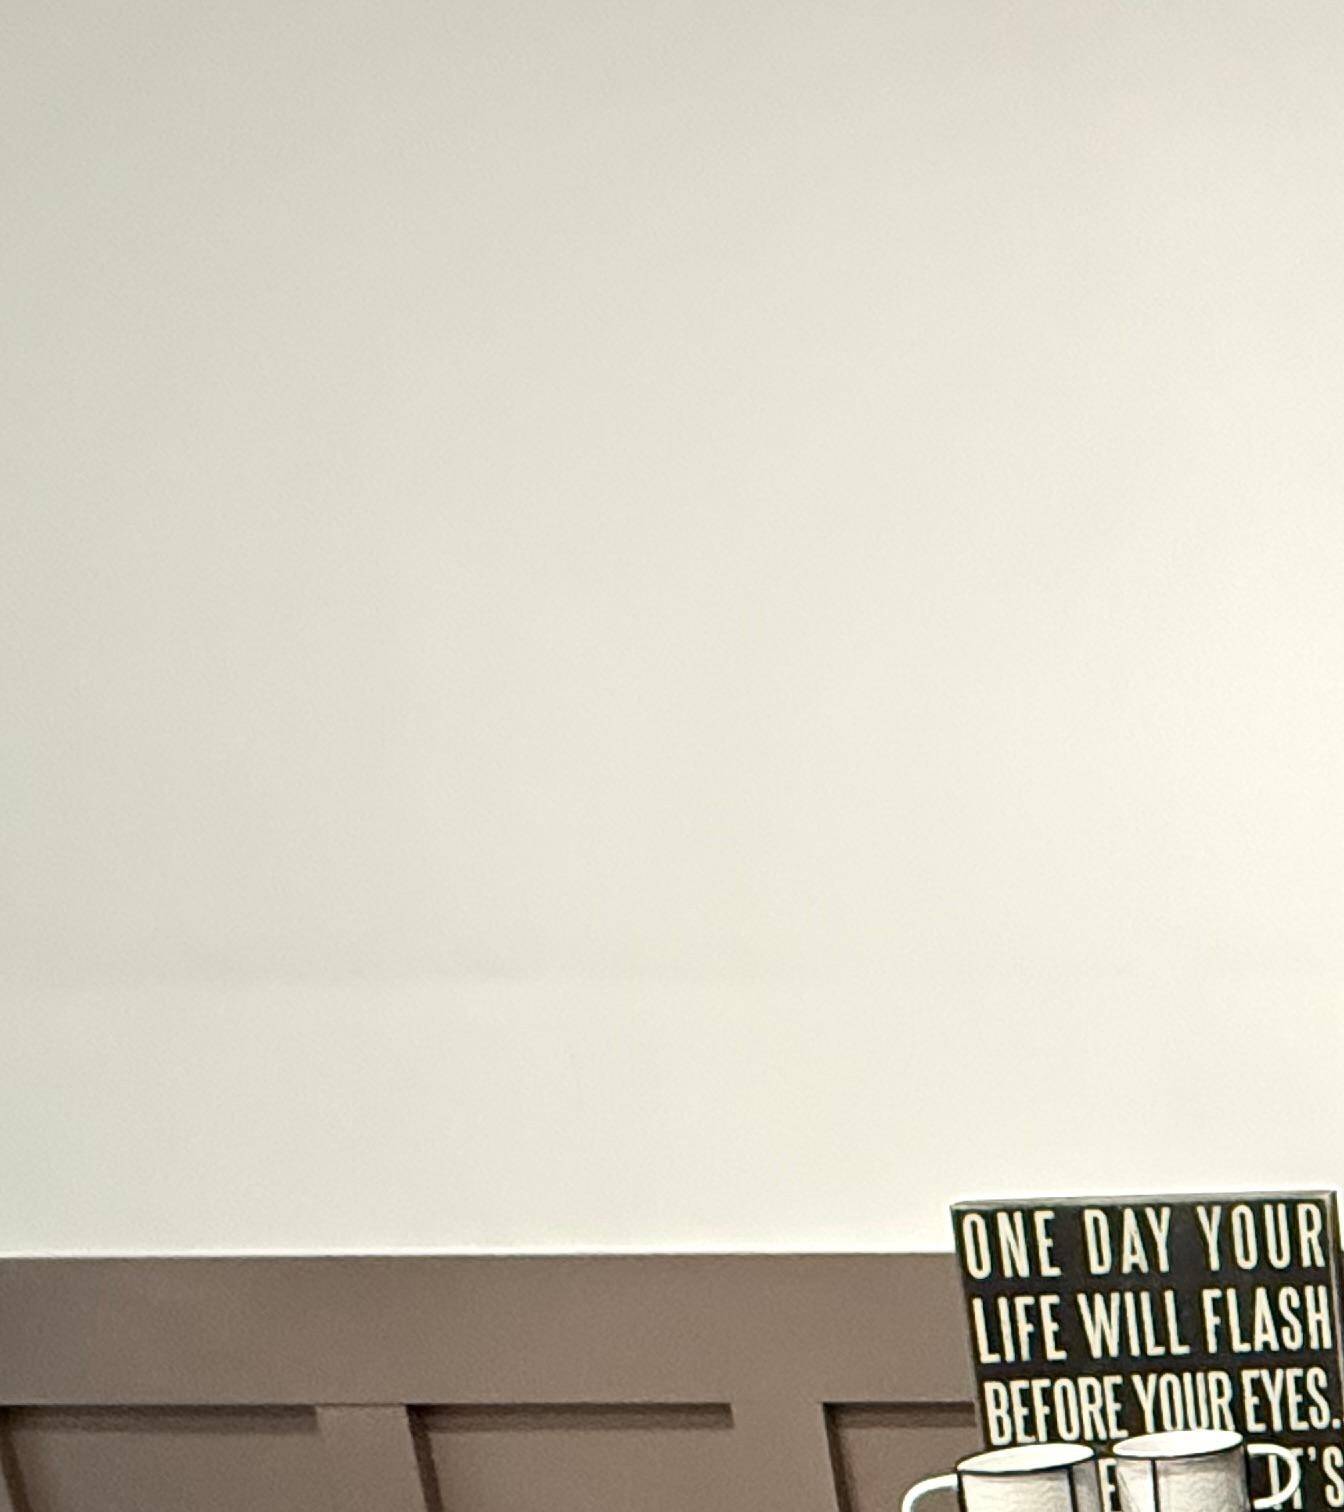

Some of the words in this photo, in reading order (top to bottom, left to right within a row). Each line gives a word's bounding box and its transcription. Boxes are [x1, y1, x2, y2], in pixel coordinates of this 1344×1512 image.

[963, 1210, 1061, 1279] ONE
[1084, 1207, 1172, 1275] DAY
[1197, 1203, 1326, 1271] YOUR
[972, 1294, 1067, 1363] LIFE
[1077, 1289, 1190, 1359] WILL
[1202, 1285, 1333, 1353] FLASH
[984, 1376, 1128, 1445] BEFORE
[1132, 1370, 1235, 1434] YOUR
[1241, 1367, 1342, 1433] EYES.
